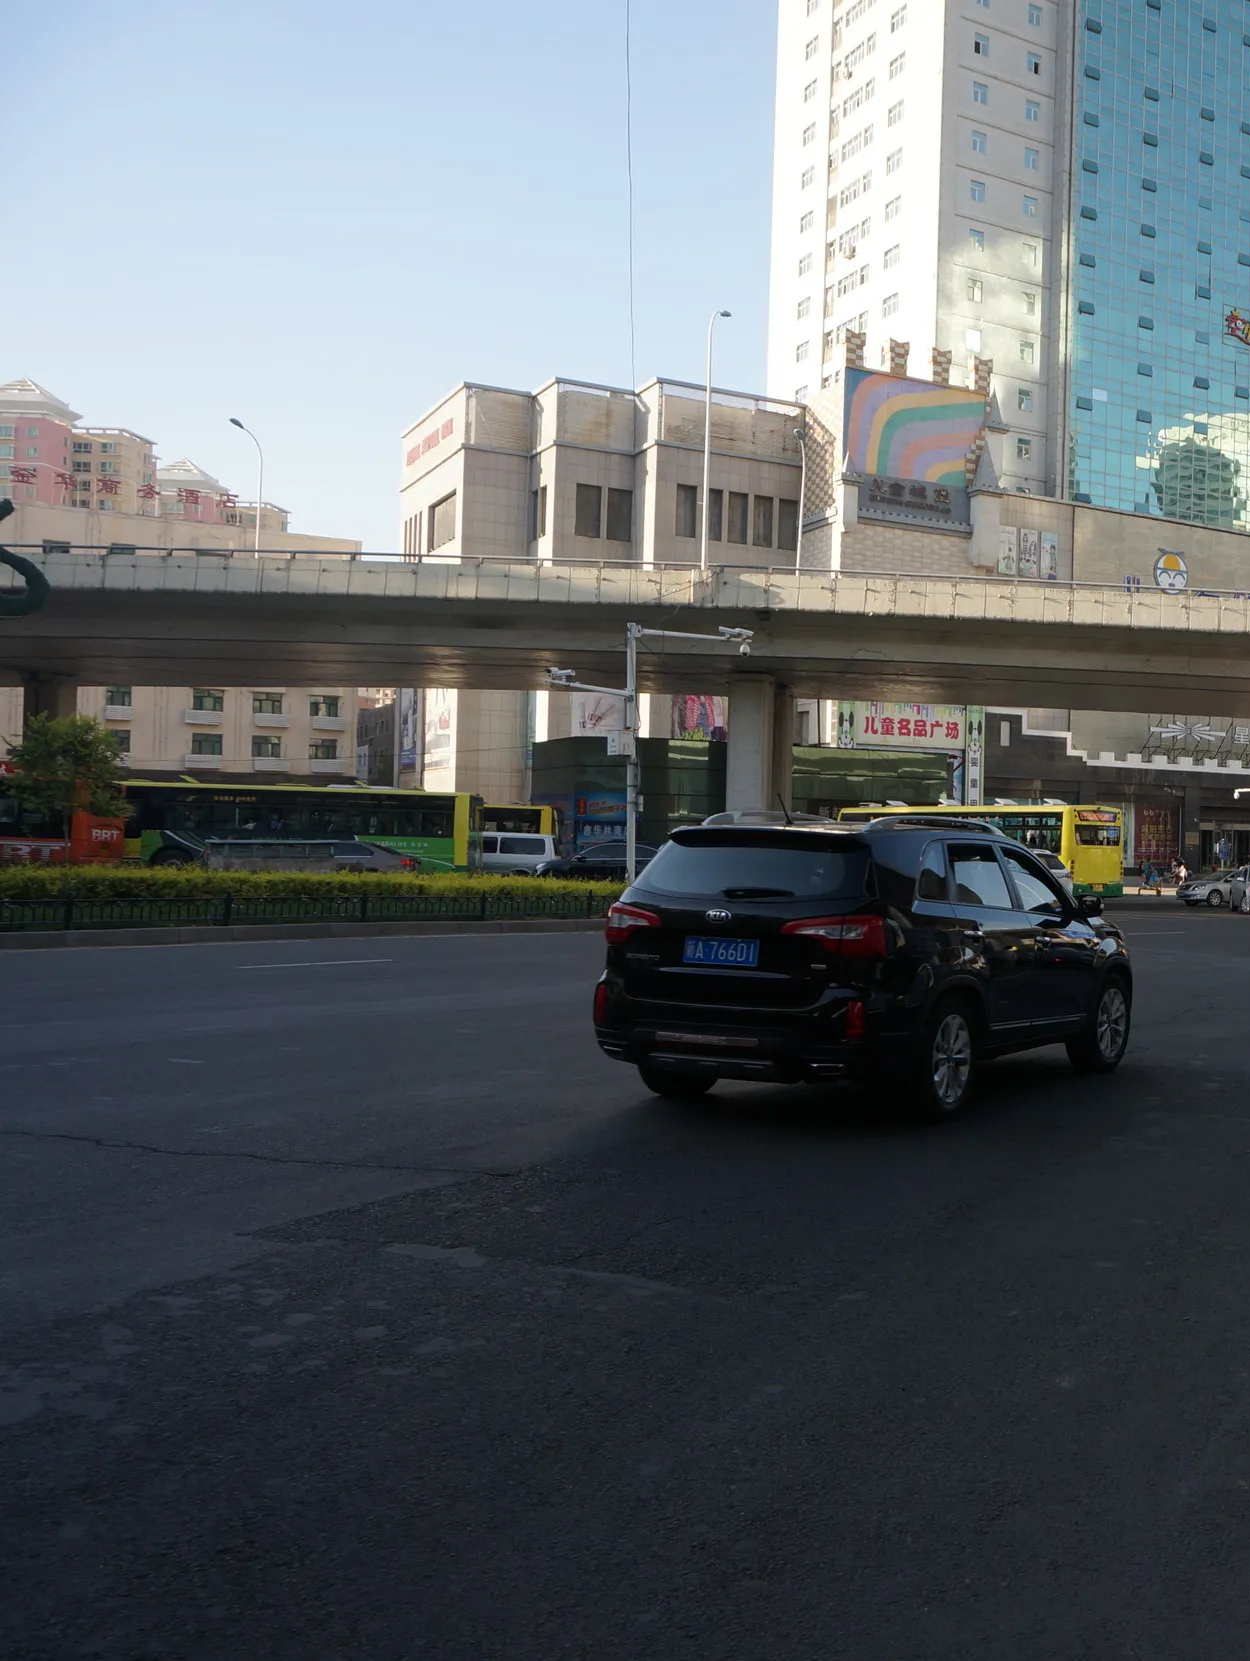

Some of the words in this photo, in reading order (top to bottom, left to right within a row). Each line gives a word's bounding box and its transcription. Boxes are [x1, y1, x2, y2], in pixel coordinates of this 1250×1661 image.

[9, 466, 239, 508] 金华商务酒店
[864, 716, 960, 740] 儿童名品广场
[708, 910, 730, 920] KIA
